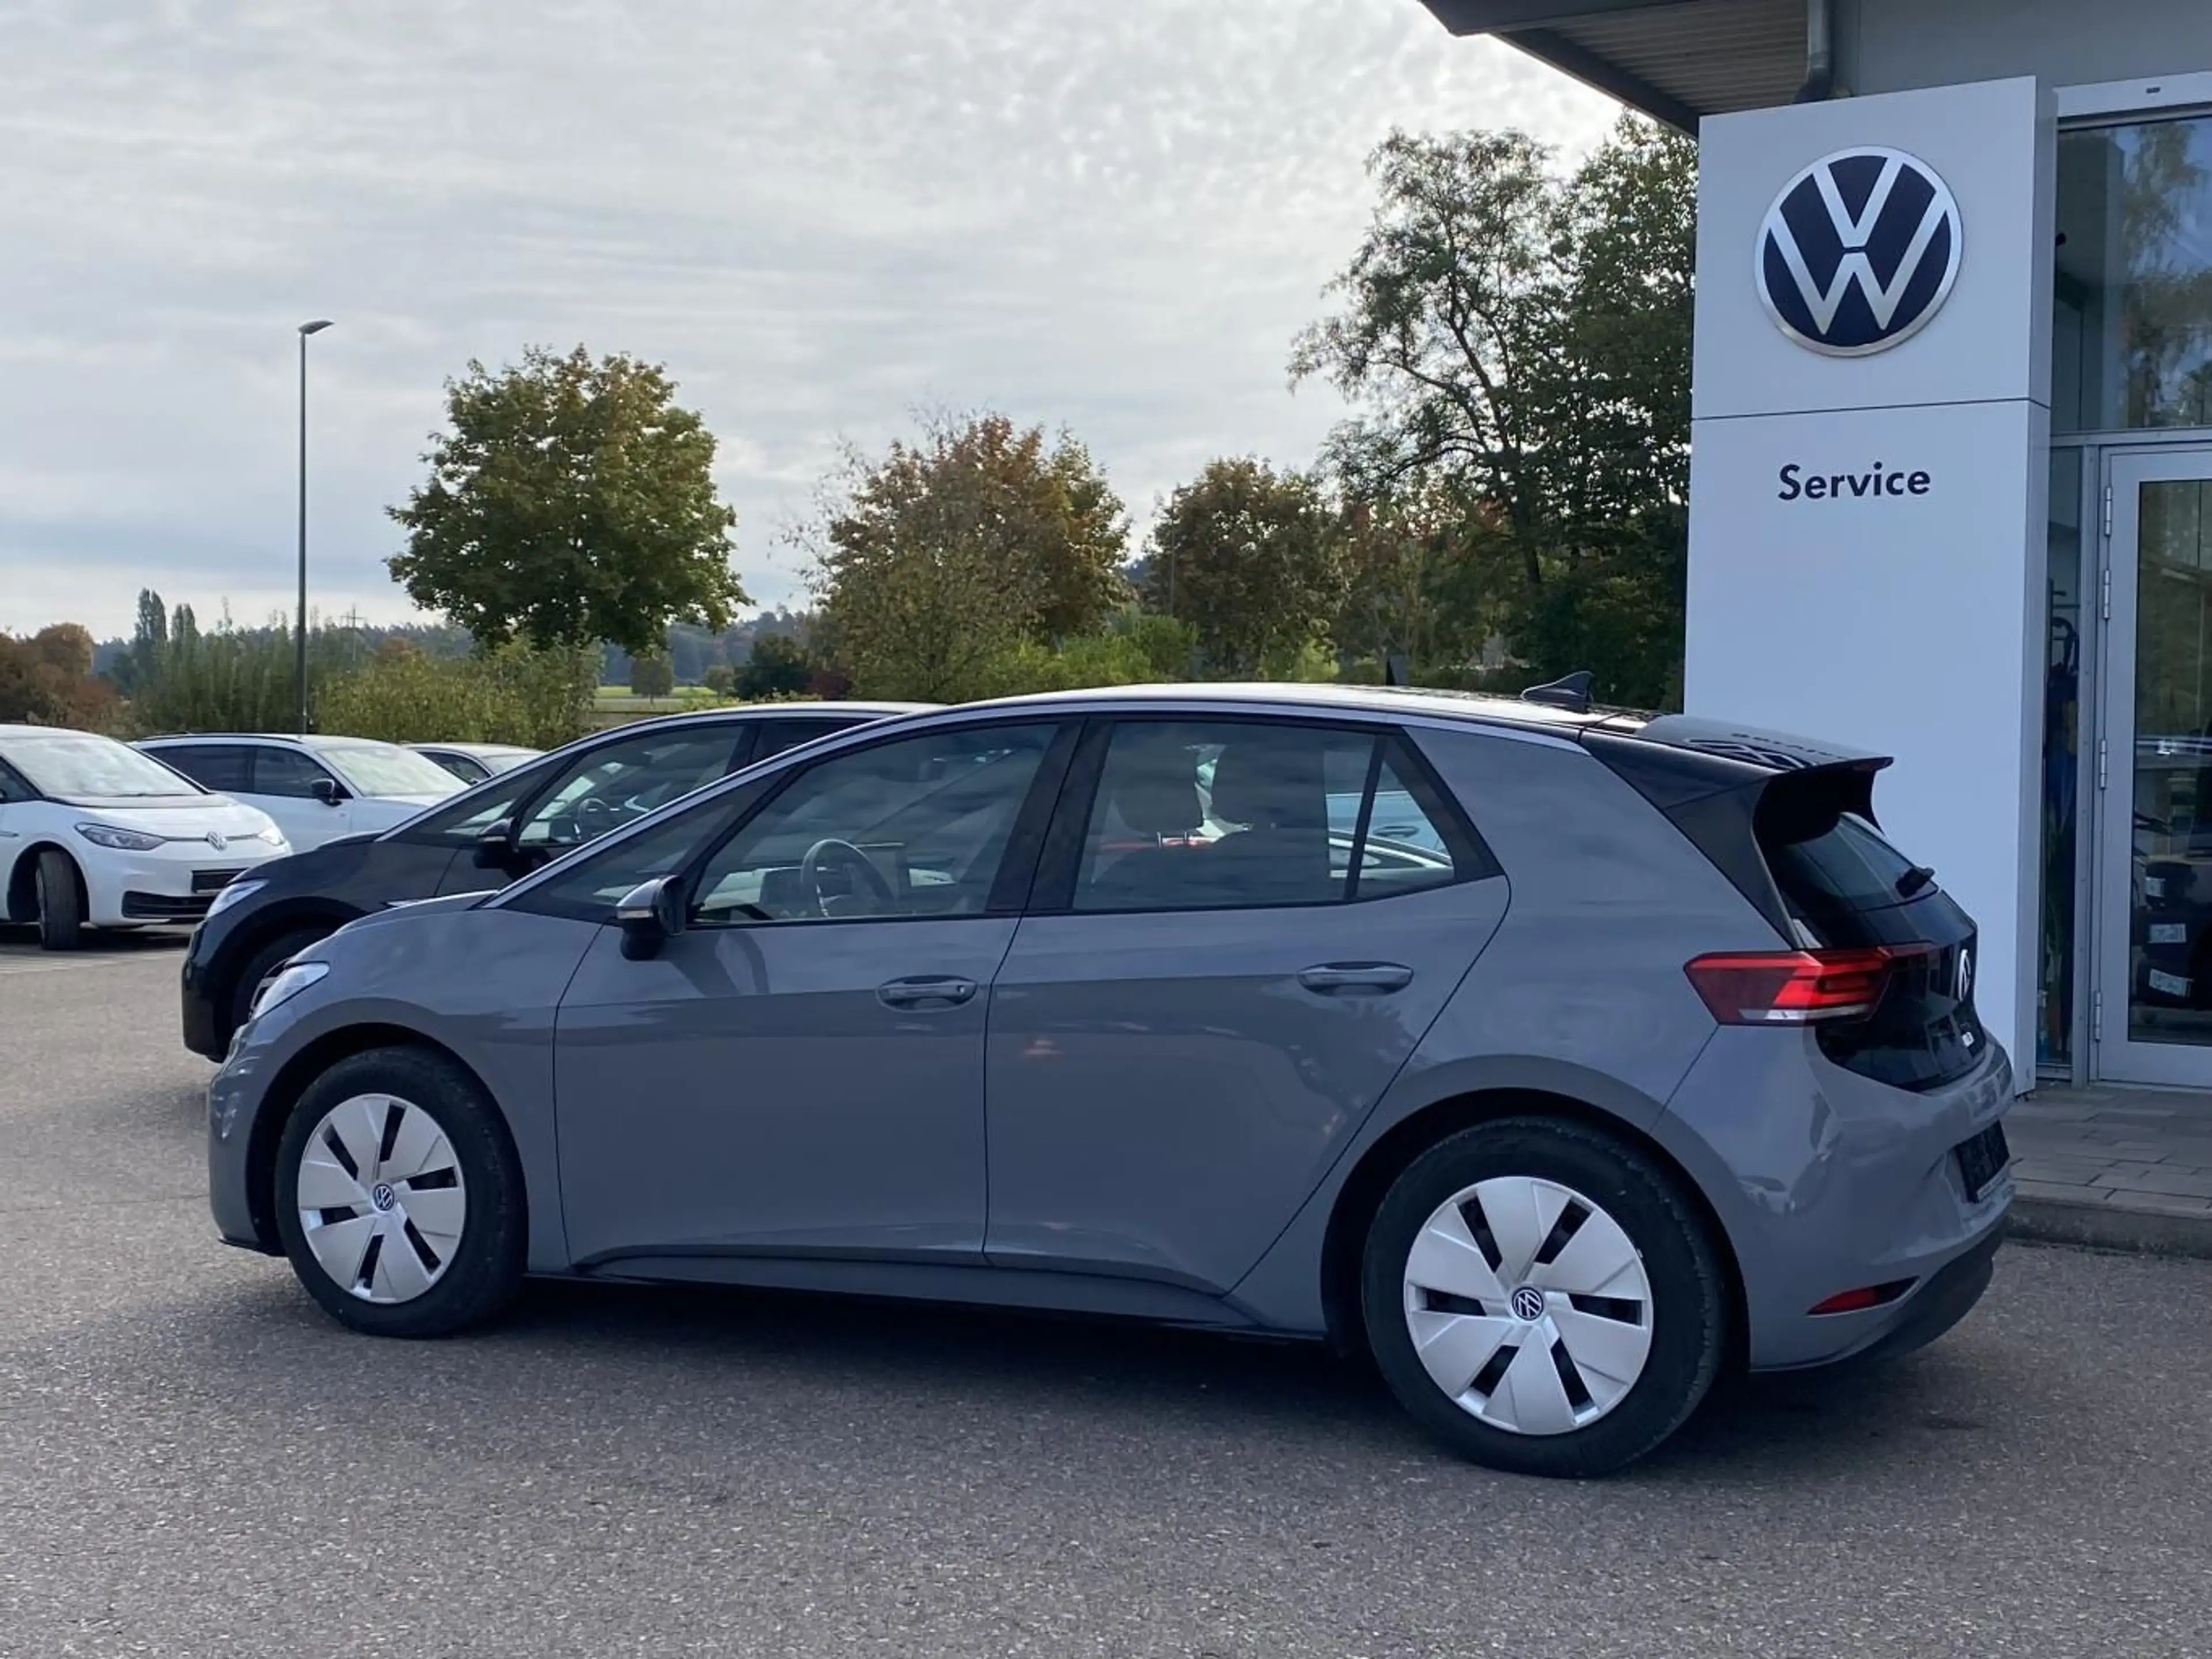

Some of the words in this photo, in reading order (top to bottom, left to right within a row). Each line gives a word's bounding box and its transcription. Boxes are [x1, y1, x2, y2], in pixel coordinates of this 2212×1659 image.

[1762, 150, 1952, 337] VW
[1778, 461, 1930, 500] Service
[1514, 1289, 1542, 1319] VW
